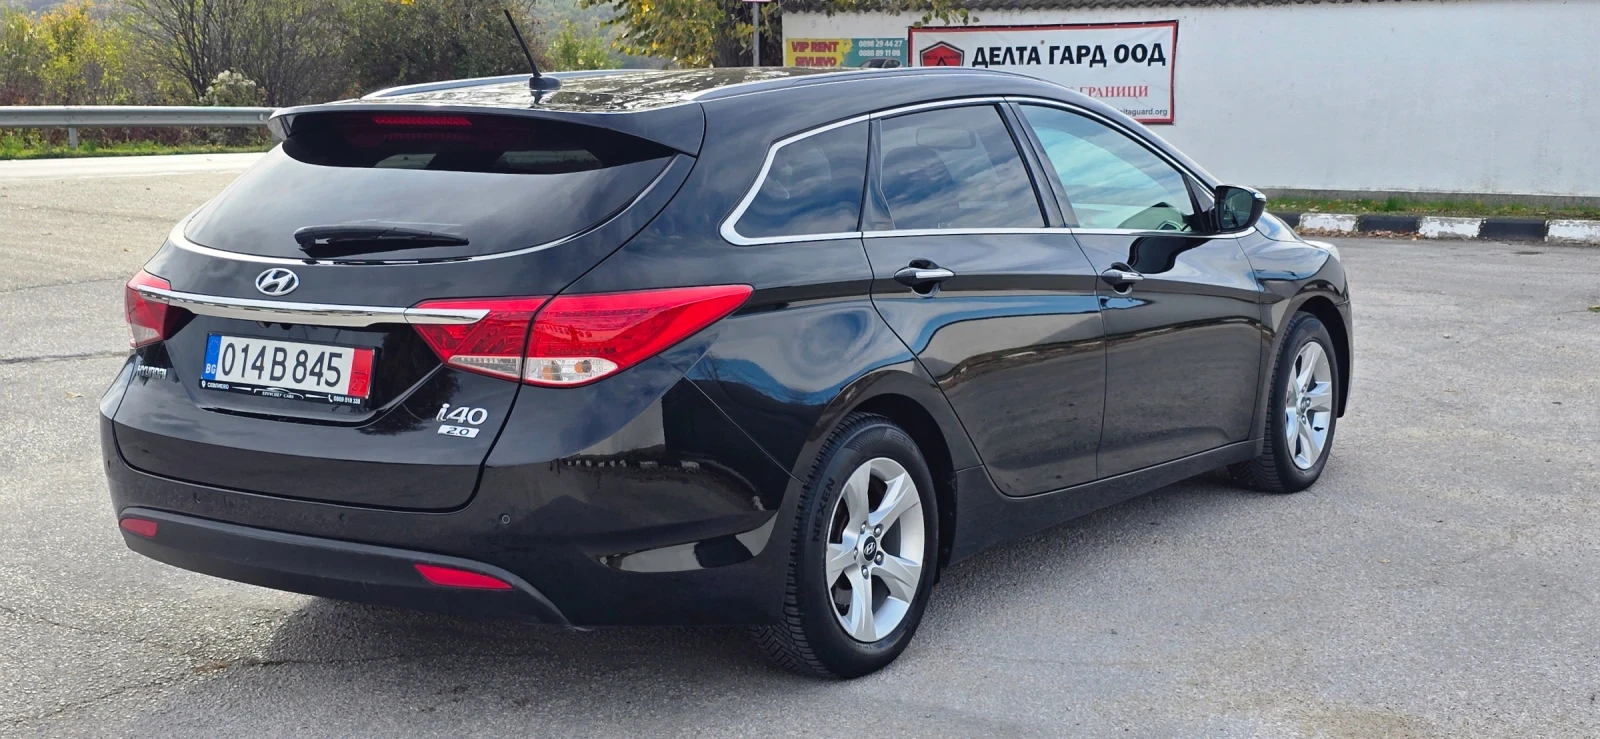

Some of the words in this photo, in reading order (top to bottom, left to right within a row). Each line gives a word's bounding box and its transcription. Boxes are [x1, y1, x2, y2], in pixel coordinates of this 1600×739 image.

[791, 41, 809, 52] VIP
[811, 41, 839, 52] RENT
[884, 40, 894, 48] 44
[894, 40, 903, 48] 27
[885, 49, 892, 57] 11
[972, 46, 1041, 68] ДЕЛТА
[1049, 44, 1107, 67] ГАРД
[1113, 43, 1166, 67] ООД
[1117, 108, 1168, 117] eltaguard.org
[205, 363, 217, 374] BG
[436, 403, 488, 425] i40
[446, 427, 470, 436] 2.0
[811, 477, 835, 542] NEXEN
